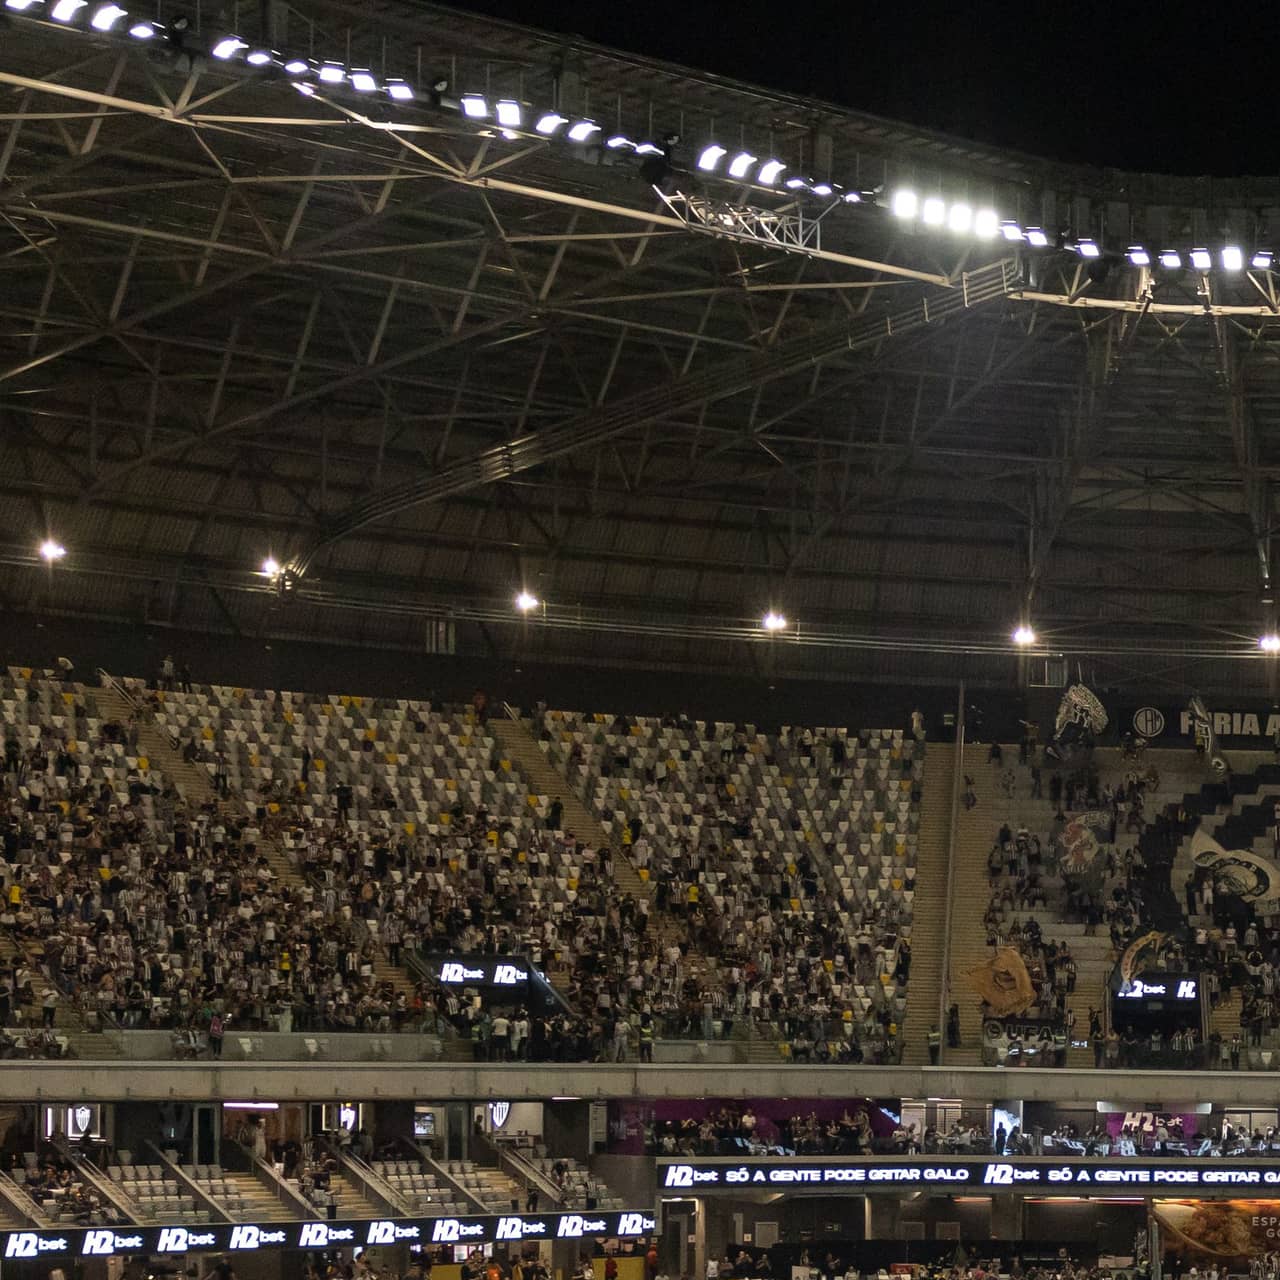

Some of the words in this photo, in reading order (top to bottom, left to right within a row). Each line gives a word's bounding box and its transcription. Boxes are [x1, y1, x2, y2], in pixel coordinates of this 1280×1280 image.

[1180, 711, 1264, 736] FRIA
[665, 1166, 718, 1186] H2bet
[726, 1168, 749, 1181] SÓ
[753, 1171, 765, 1181] A
[770, 1170, 821, 1181] GENTE
[825, 1170, 865, 1181] PODE
[869, 1169, 920, 1180] GRITAR
[924, 1169, 969, 1180] GALO
[984, 1165, 1039, 1185] H2bet
[1048, 1168, 1072, 1181] SÓ
[1077, 1171, 1090, 1181] A
[1095, 1170, 1149, 1182] GENTE
[1154, 1171, 1198, 1182] PODE
[1203, 1171, 1260, 1182] GRITAR
[5, 1234, 67, 1258] H2bet
[82, 1231, 142, 1255] H2bet
[157, 1228, 215, 1252] H2bet
[230, 1226, 285, 1249] H2bet
[299, 1224, 353, 1246] H2bet
[367, 1221, 420, 1244] H2bet
[432, 1219, 484, 1241] H2bet
[495, 1217, 546, 1239] H2bet
[558, 1215, 606, 1237] H2bet
